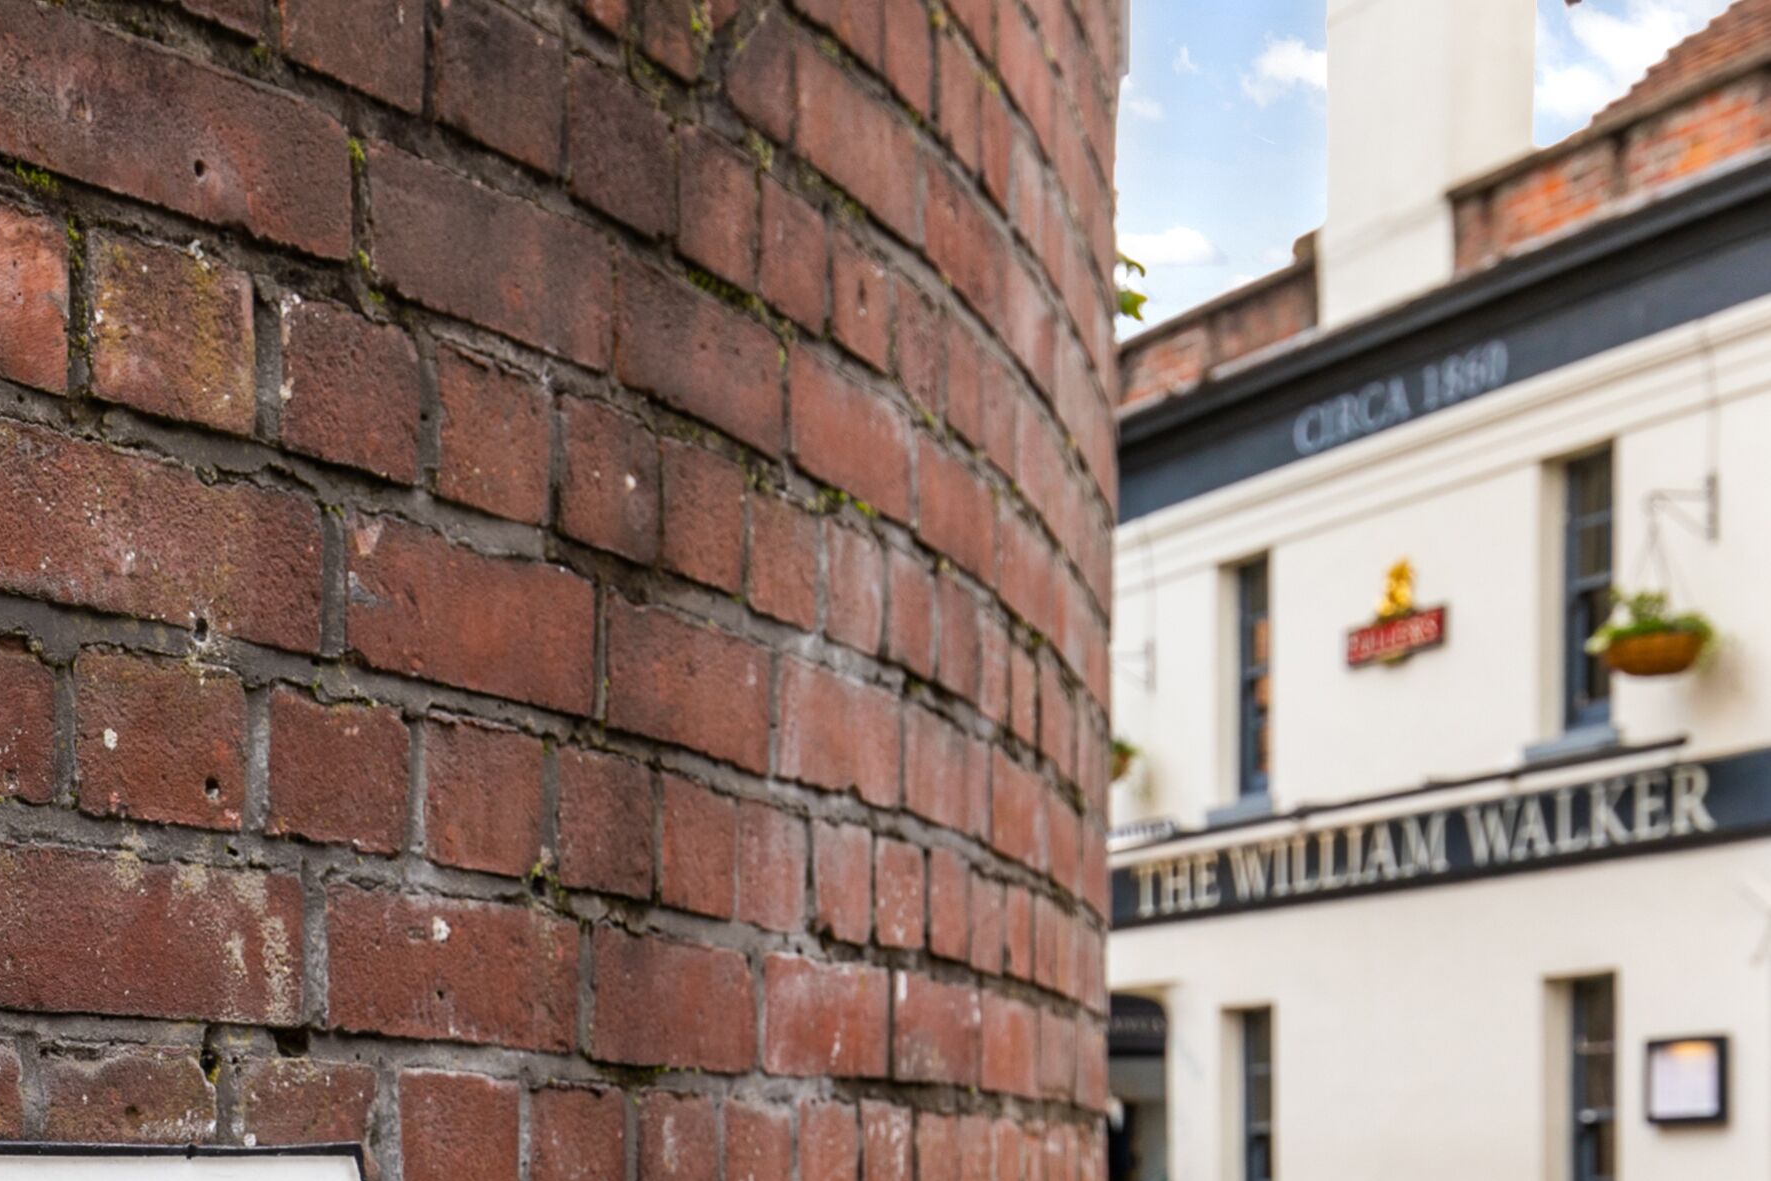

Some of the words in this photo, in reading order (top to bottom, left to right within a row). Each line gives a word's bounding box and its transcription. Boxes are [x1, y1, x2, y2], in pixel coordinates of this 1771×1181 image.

[1293, 376, 1412, 455] CIRCA
[1134, 851, 1222, 918] THE
[1229, 810, 1450, 904] WILLIAM
[1463, 763, 1717, 867] WALKER
